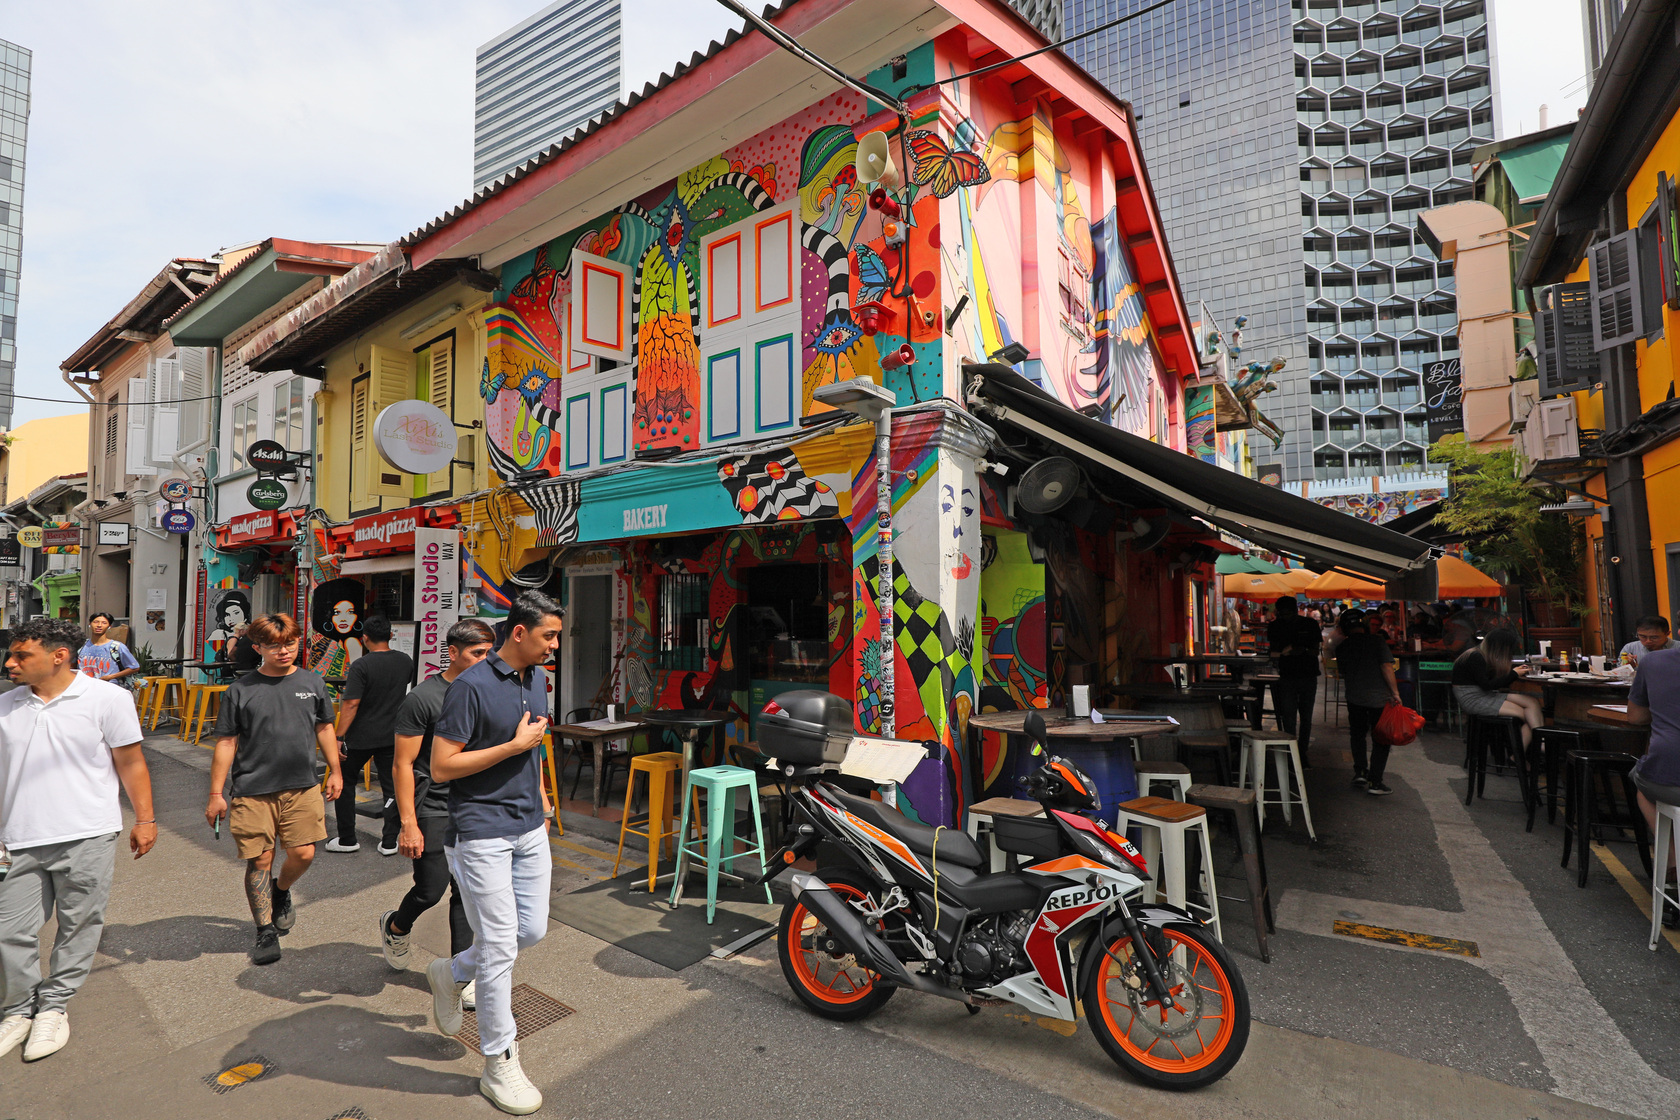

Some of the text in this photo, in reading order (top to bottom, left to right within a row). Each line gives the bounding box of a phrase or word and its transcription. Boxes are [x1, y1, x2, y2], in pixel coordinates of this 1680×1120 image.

[384, 429, 412, 442] Lash
[416, 436, 453, 450] Studio
[252, 448, 283, 460] Asahi
[252, 488, 285, 499] Carlsberg
[623, 504, 668, 532] BAKERY
[386, 516, 416, 543] pizza
[442, 542, 454, 560] WAX
[150, 564, 168, 574] 17
[422, 542, 439, 604] Studio
[441, 591, 453, 610] NAIL
[421, 610, 438, 655] Lash
[1046, 884, 1122, 910] REPSOL
